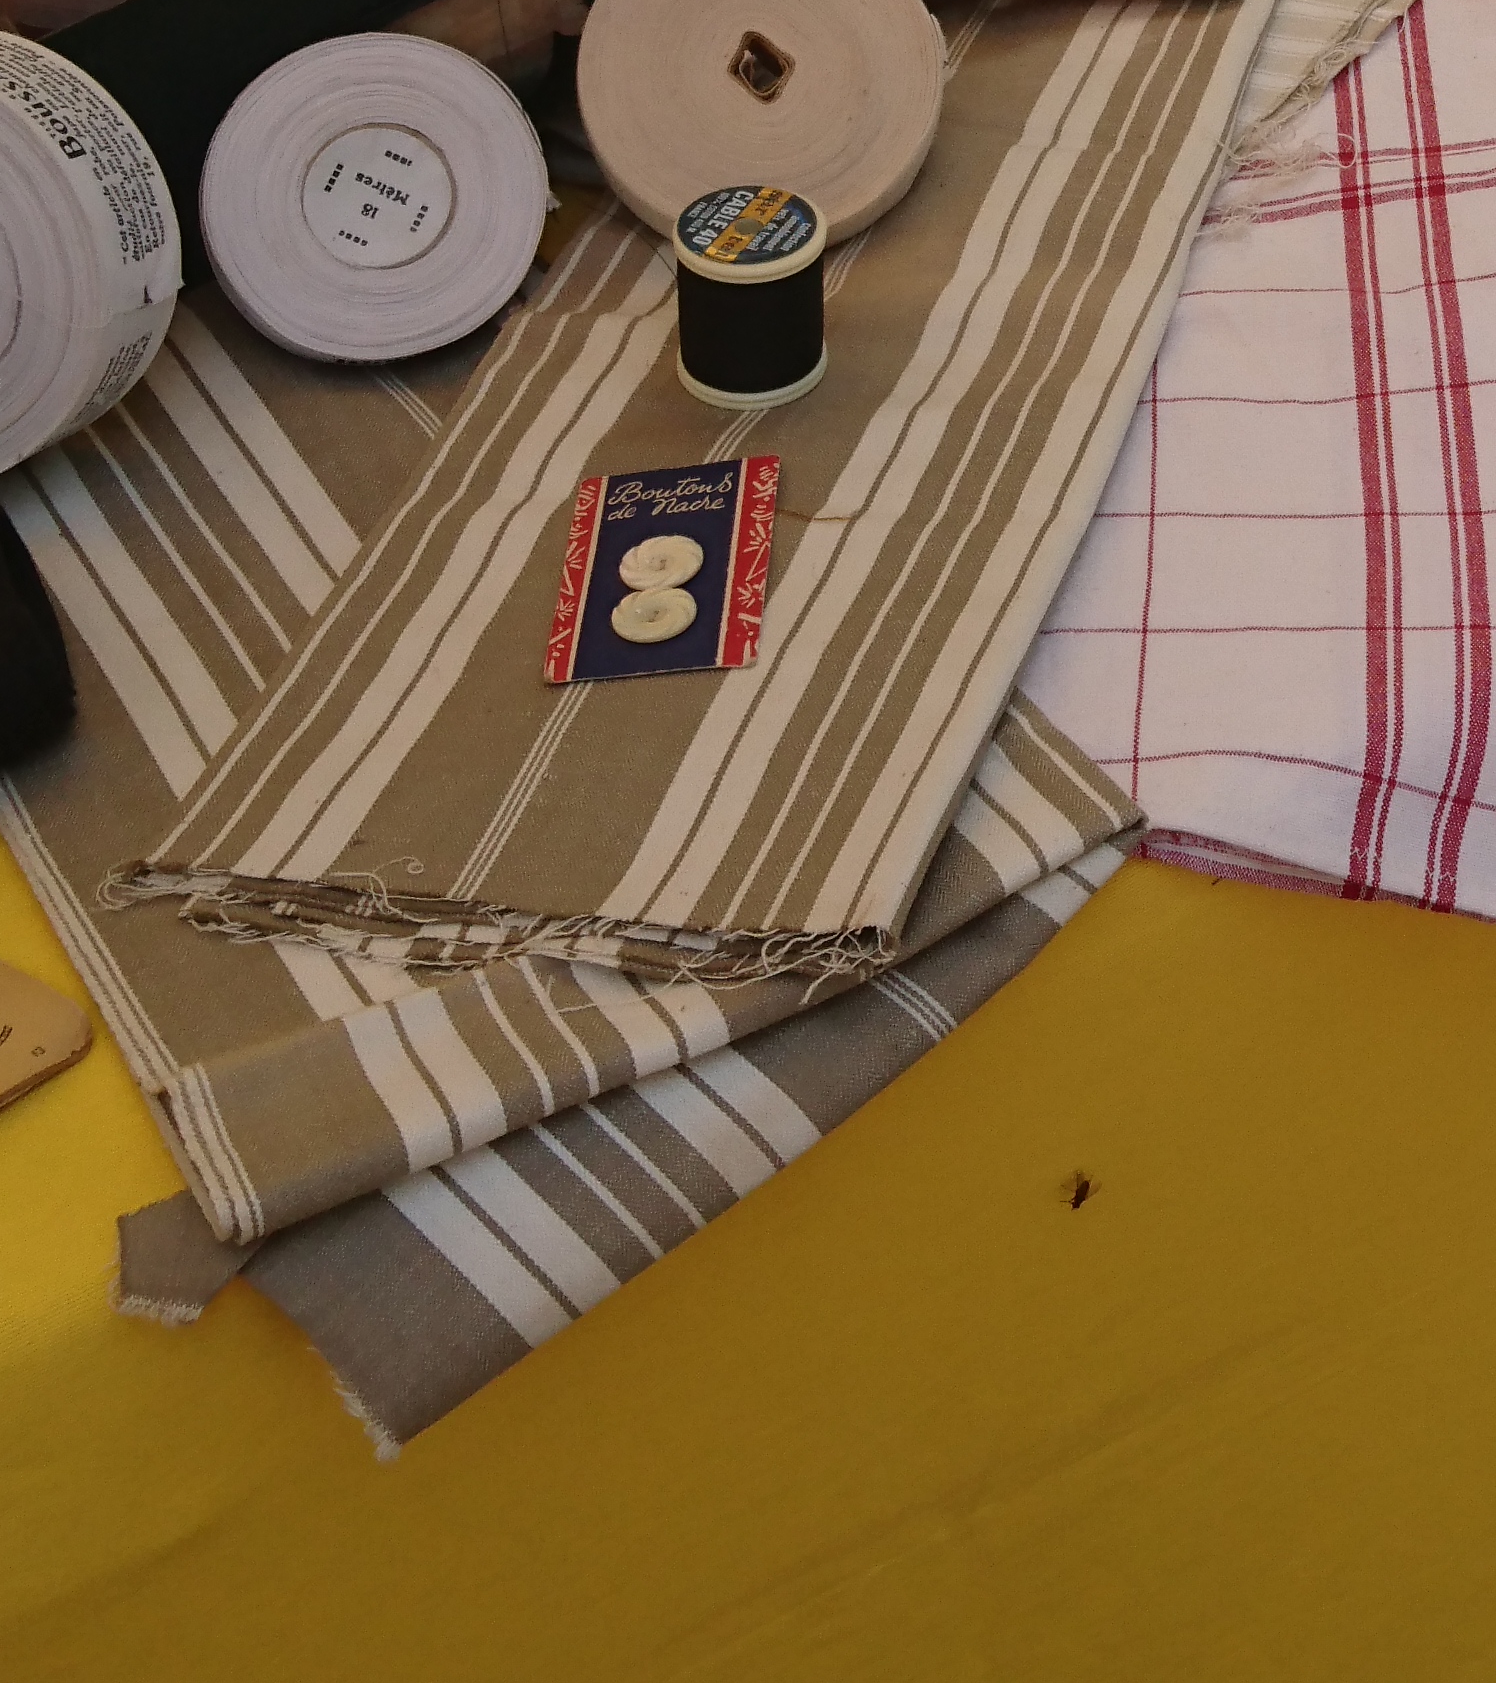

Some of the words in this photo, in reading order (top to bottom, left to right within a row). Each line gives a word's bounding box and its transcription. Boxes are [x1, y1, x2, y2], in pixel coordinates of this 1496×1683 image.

[101, 184, 124, 227] article
[360, 202, 380, 220] 18
[705, 189, 755, 230] CABLE
[690, 228, 719, 246] 40
[607, 472, 734, 505] Boutons
[607, 504, 638, 522] de
[651, 496, 726, 517] Nacre
